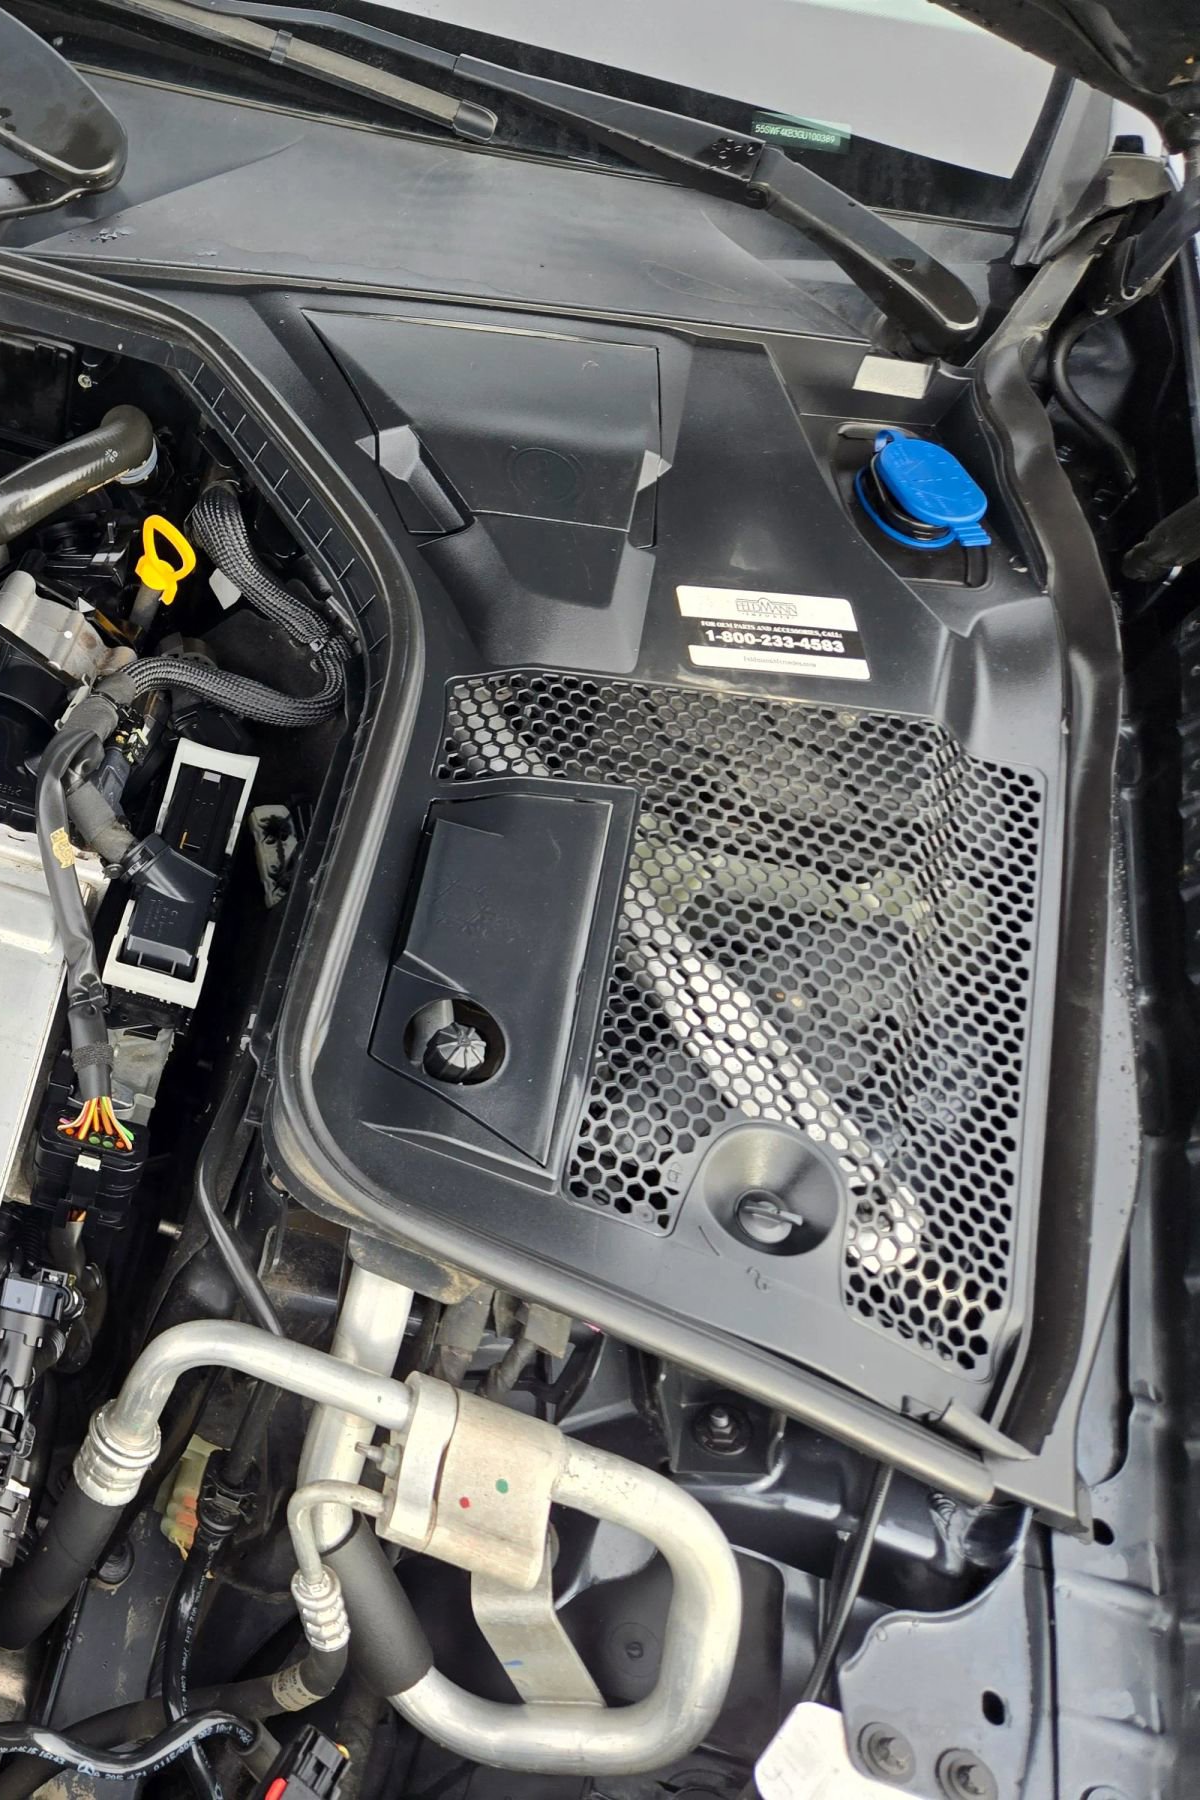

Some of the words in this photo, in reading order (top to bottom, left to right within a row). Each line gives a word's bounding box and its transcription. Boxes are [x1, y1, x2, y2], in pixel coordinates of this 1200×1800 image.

[733, 622, 756, 631] PARTS
[756, 624, 772, 632] AND
[822, 630, 843, 639] CALL:
[705, 629, 846, 653] 1-800-233-4583
